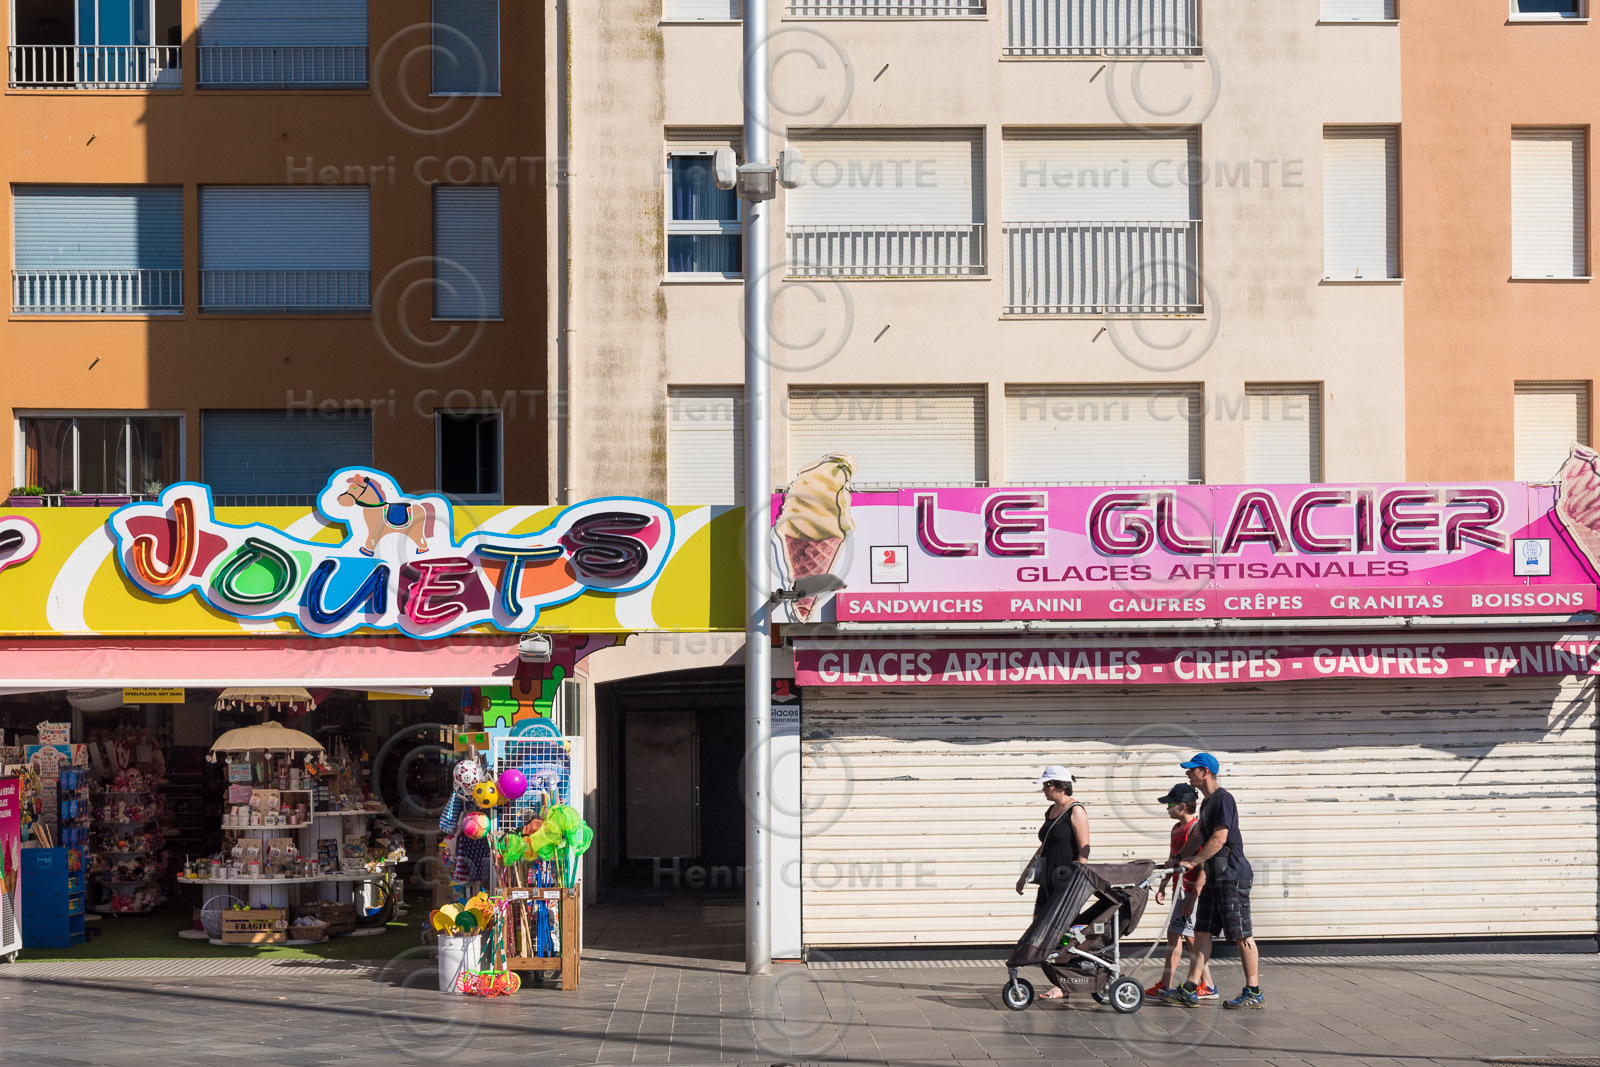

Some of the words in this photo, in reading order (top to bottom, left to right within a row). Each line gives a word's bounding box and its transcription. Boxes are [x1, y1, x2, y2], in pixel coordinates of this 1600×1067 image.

[914, 491, 1048, 559] LE
[1085, 486, 1510, 559] GLACIER
[132, 497, 656, 626] JOUETS
[1016, 564, 1152, 583] GLACES
[1168, 560, 1410, 581] ARTISANALES
[849, 598, 984, 615] SANDWICHS
[1010, 598, 1083, 613] PANINI
[1109, 597, 1207, 613] GAUFRES
[1223, 593, 1303, 611] CRÊPES
[1329, 594, 1445, 610] GRANITAS
[1470, 592, 1585, 608] BOISSONS
[818, 652, 933, 683] GLACES
[941, 650, 1142, 682] ARTISANALES
[1173, 649, 1282, 680] CREPES
[1313, 646, 1449, 676] GAUFRES
[1484, 644, 1600, 674] PANINIS
[234, 922, 275, 930] FRAGILE
